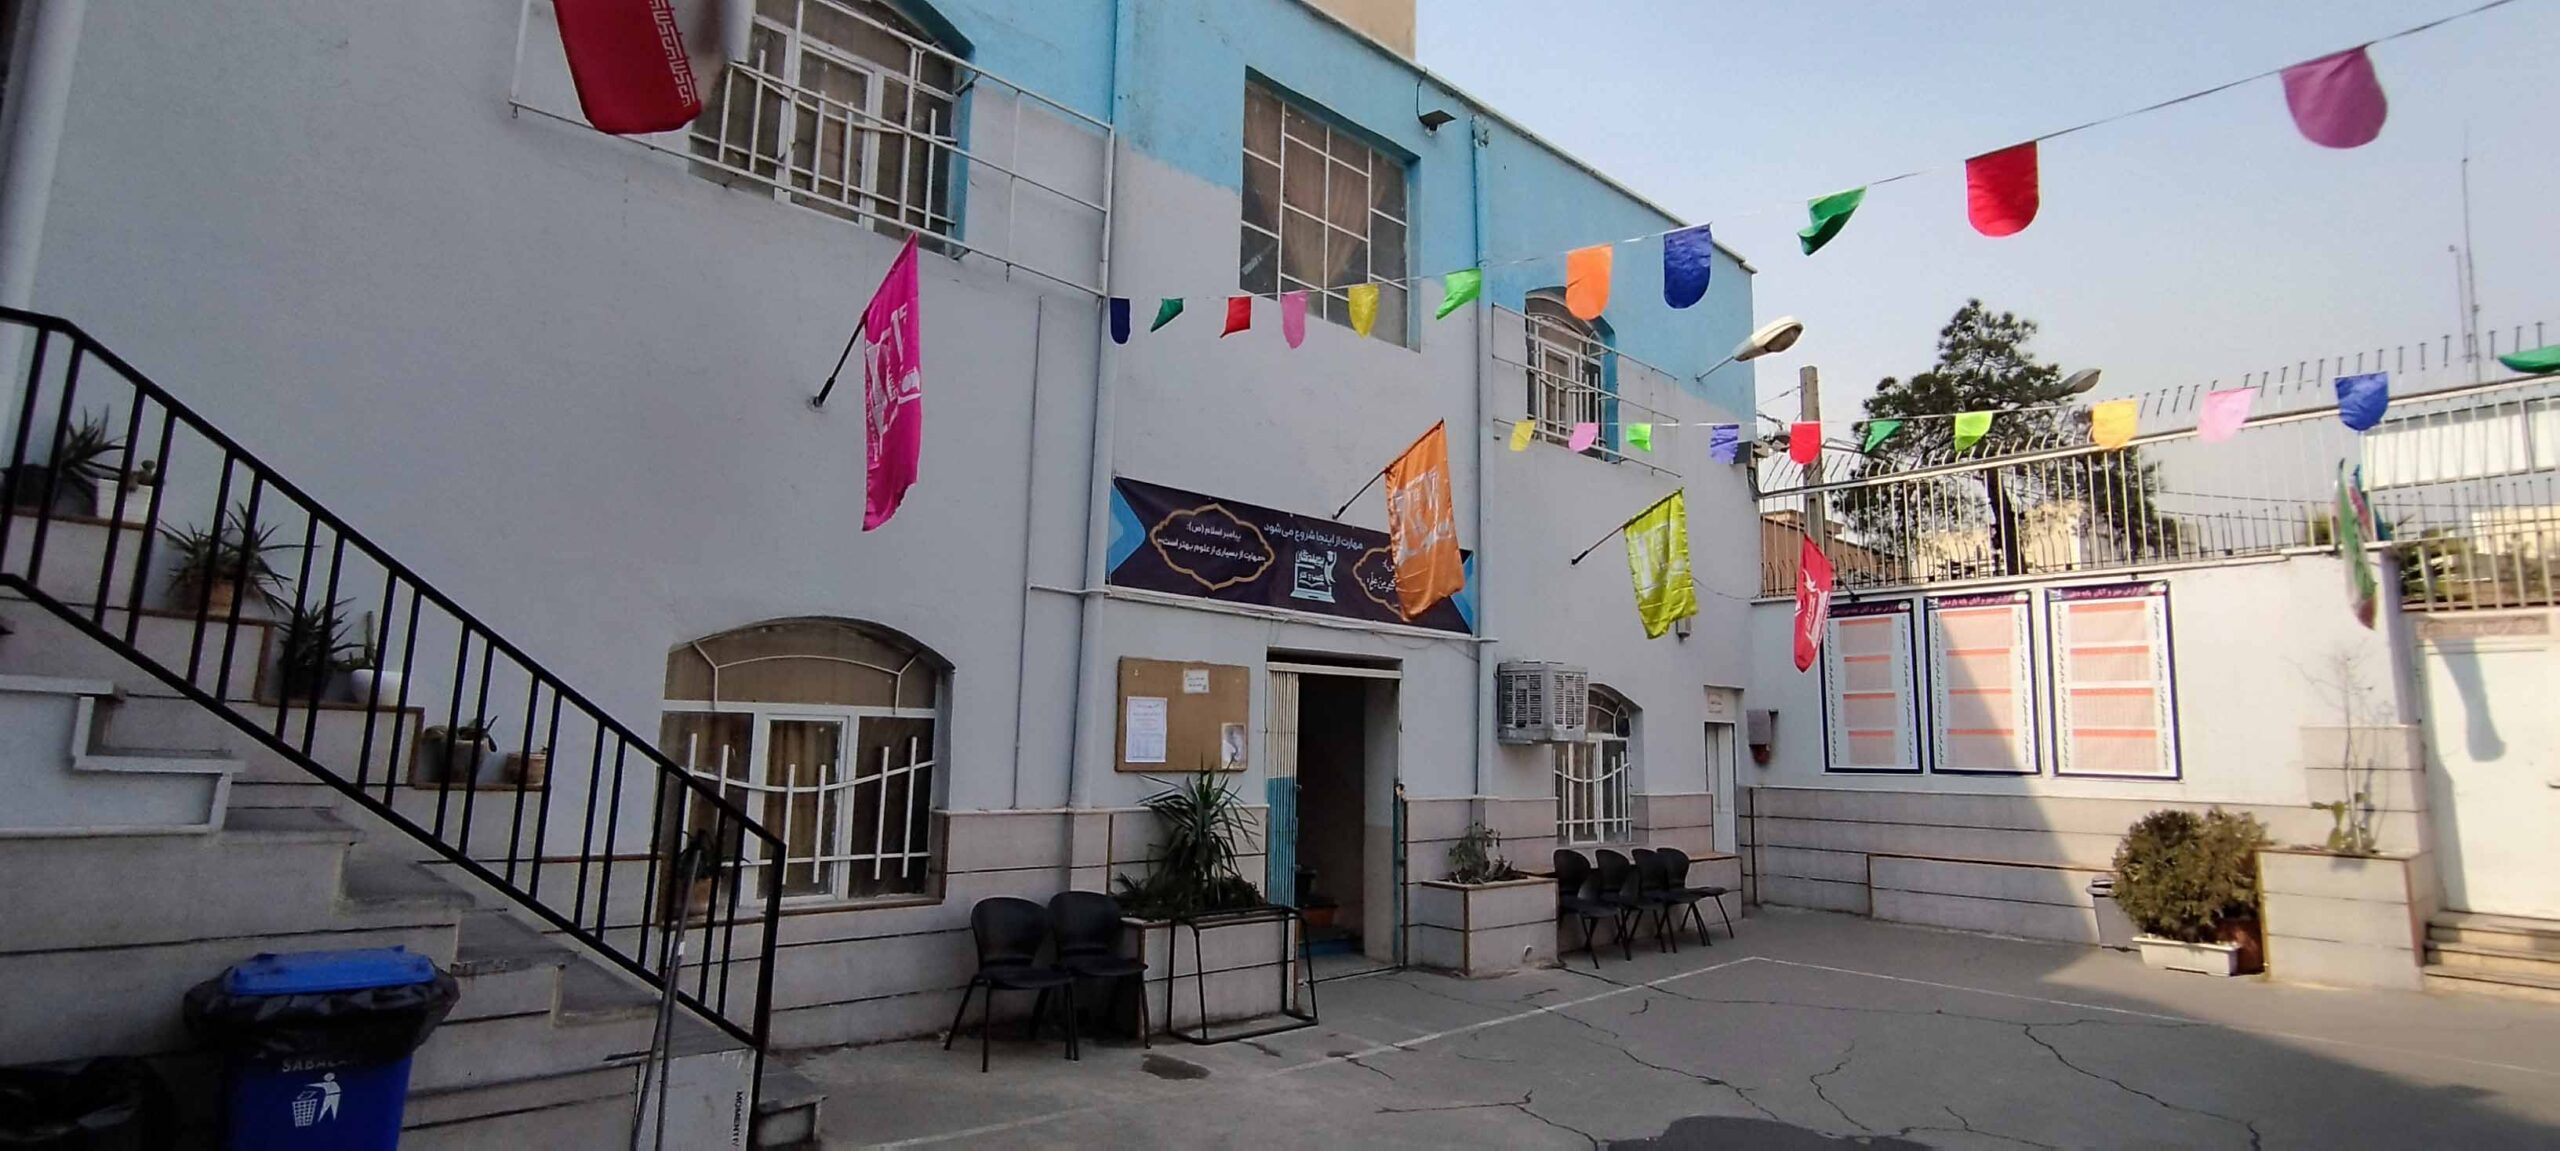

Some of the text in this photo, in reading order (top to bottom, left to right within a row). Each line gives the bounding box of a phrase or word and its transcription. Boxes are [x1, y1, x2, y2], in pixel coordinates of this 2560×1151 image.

[1205, 525, 1222, 536] اسلام
[1223, 530, 1241, 541] پیامبر
[1294, 528, 1316, 543] شروع
[1315, 531, 1334, 547] اینجا
[1334, 535, 1341, 546] از
[1343, 536, 1364, 550] مهارت
[1178, 540, 1194, 552] بهتر
[1193, 543, 1210, 554] علوم
[1209, 545, 1216, 555] از
[1215, 547, 1239, 559] بسیاری
[1238, 549, 1244, 560] از
